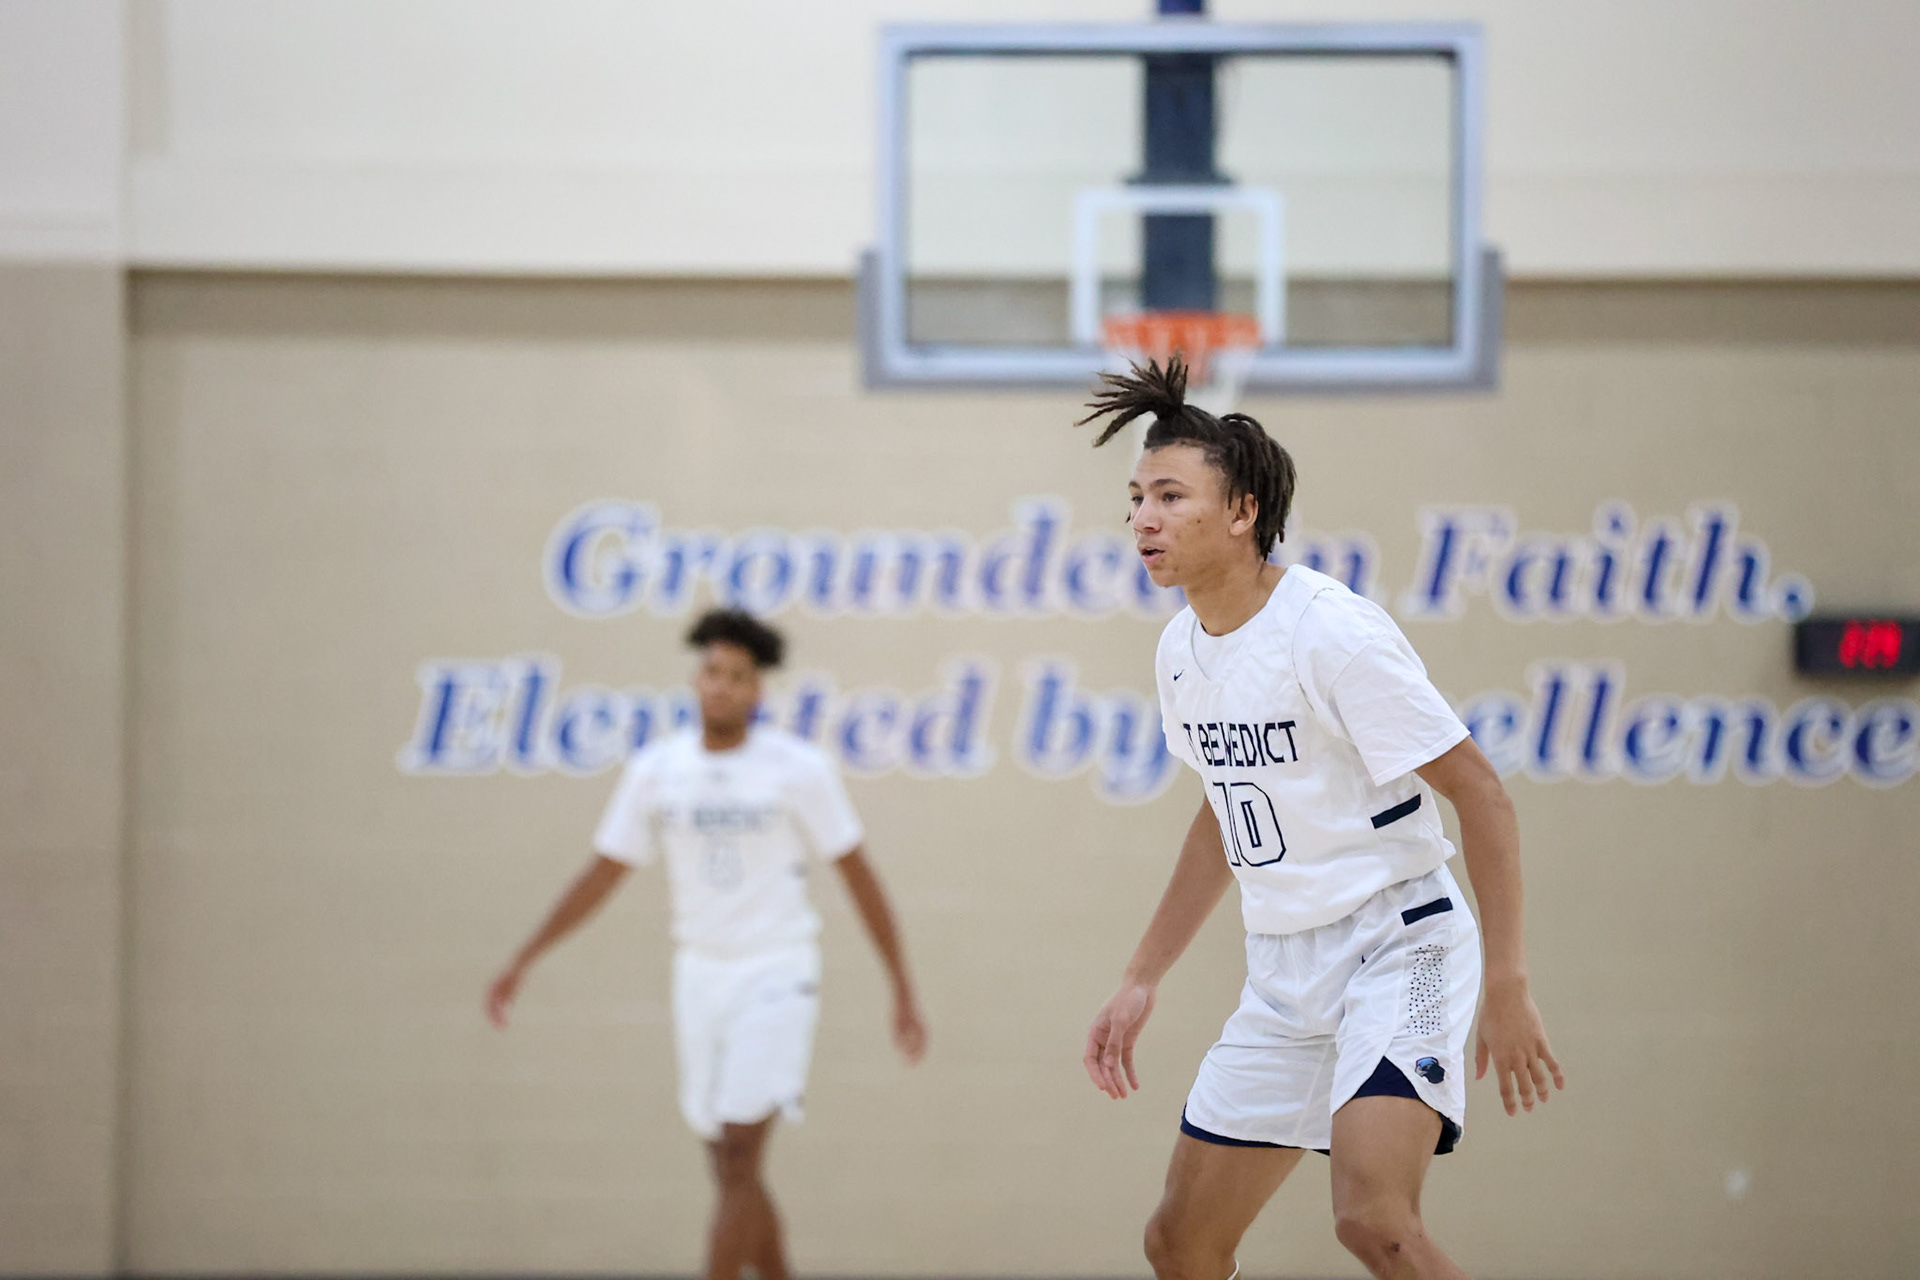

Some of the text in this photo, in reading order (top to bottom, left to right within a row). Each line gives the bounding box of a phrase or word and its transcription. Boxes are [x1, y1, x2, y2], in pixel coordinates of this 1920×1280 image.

[1401, 502, 1812, 621] Faith.
[400, 655, 1920, 803] Elevted by ellence
[1197, 720, 1298, 767] BENEDICT
[1212, 781, 1287, 867] 10
